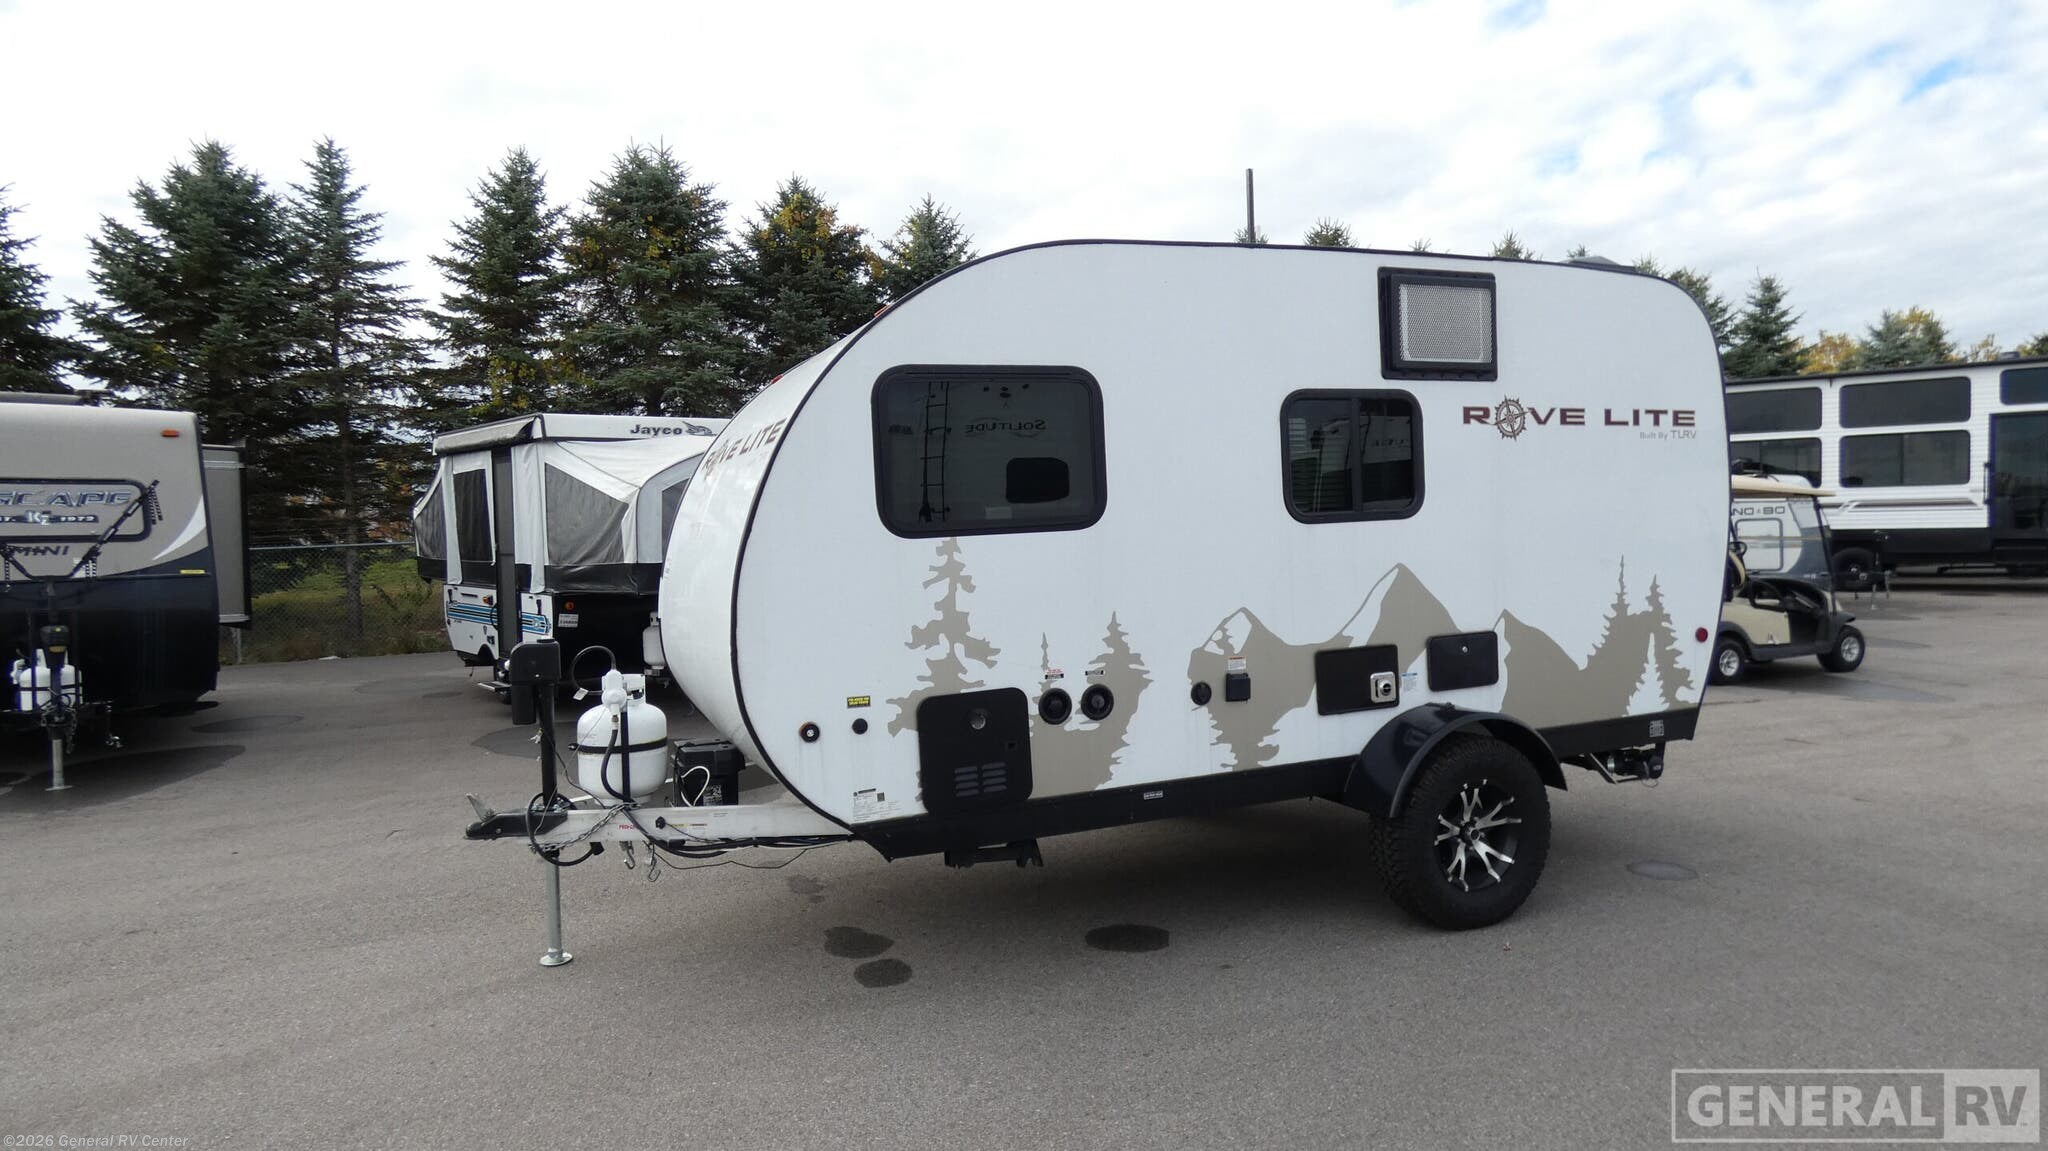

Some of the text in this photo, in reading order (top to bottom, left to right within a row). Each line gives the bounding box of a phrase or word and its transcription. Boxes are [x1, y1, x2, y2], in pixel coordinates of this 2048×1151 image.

[1604, 408, 1696, 427] LITE
[630, 424, 682, 436] Jayco
[739, 417, 788, 456] LITE
[1639, 431, 1657, 440] Built
